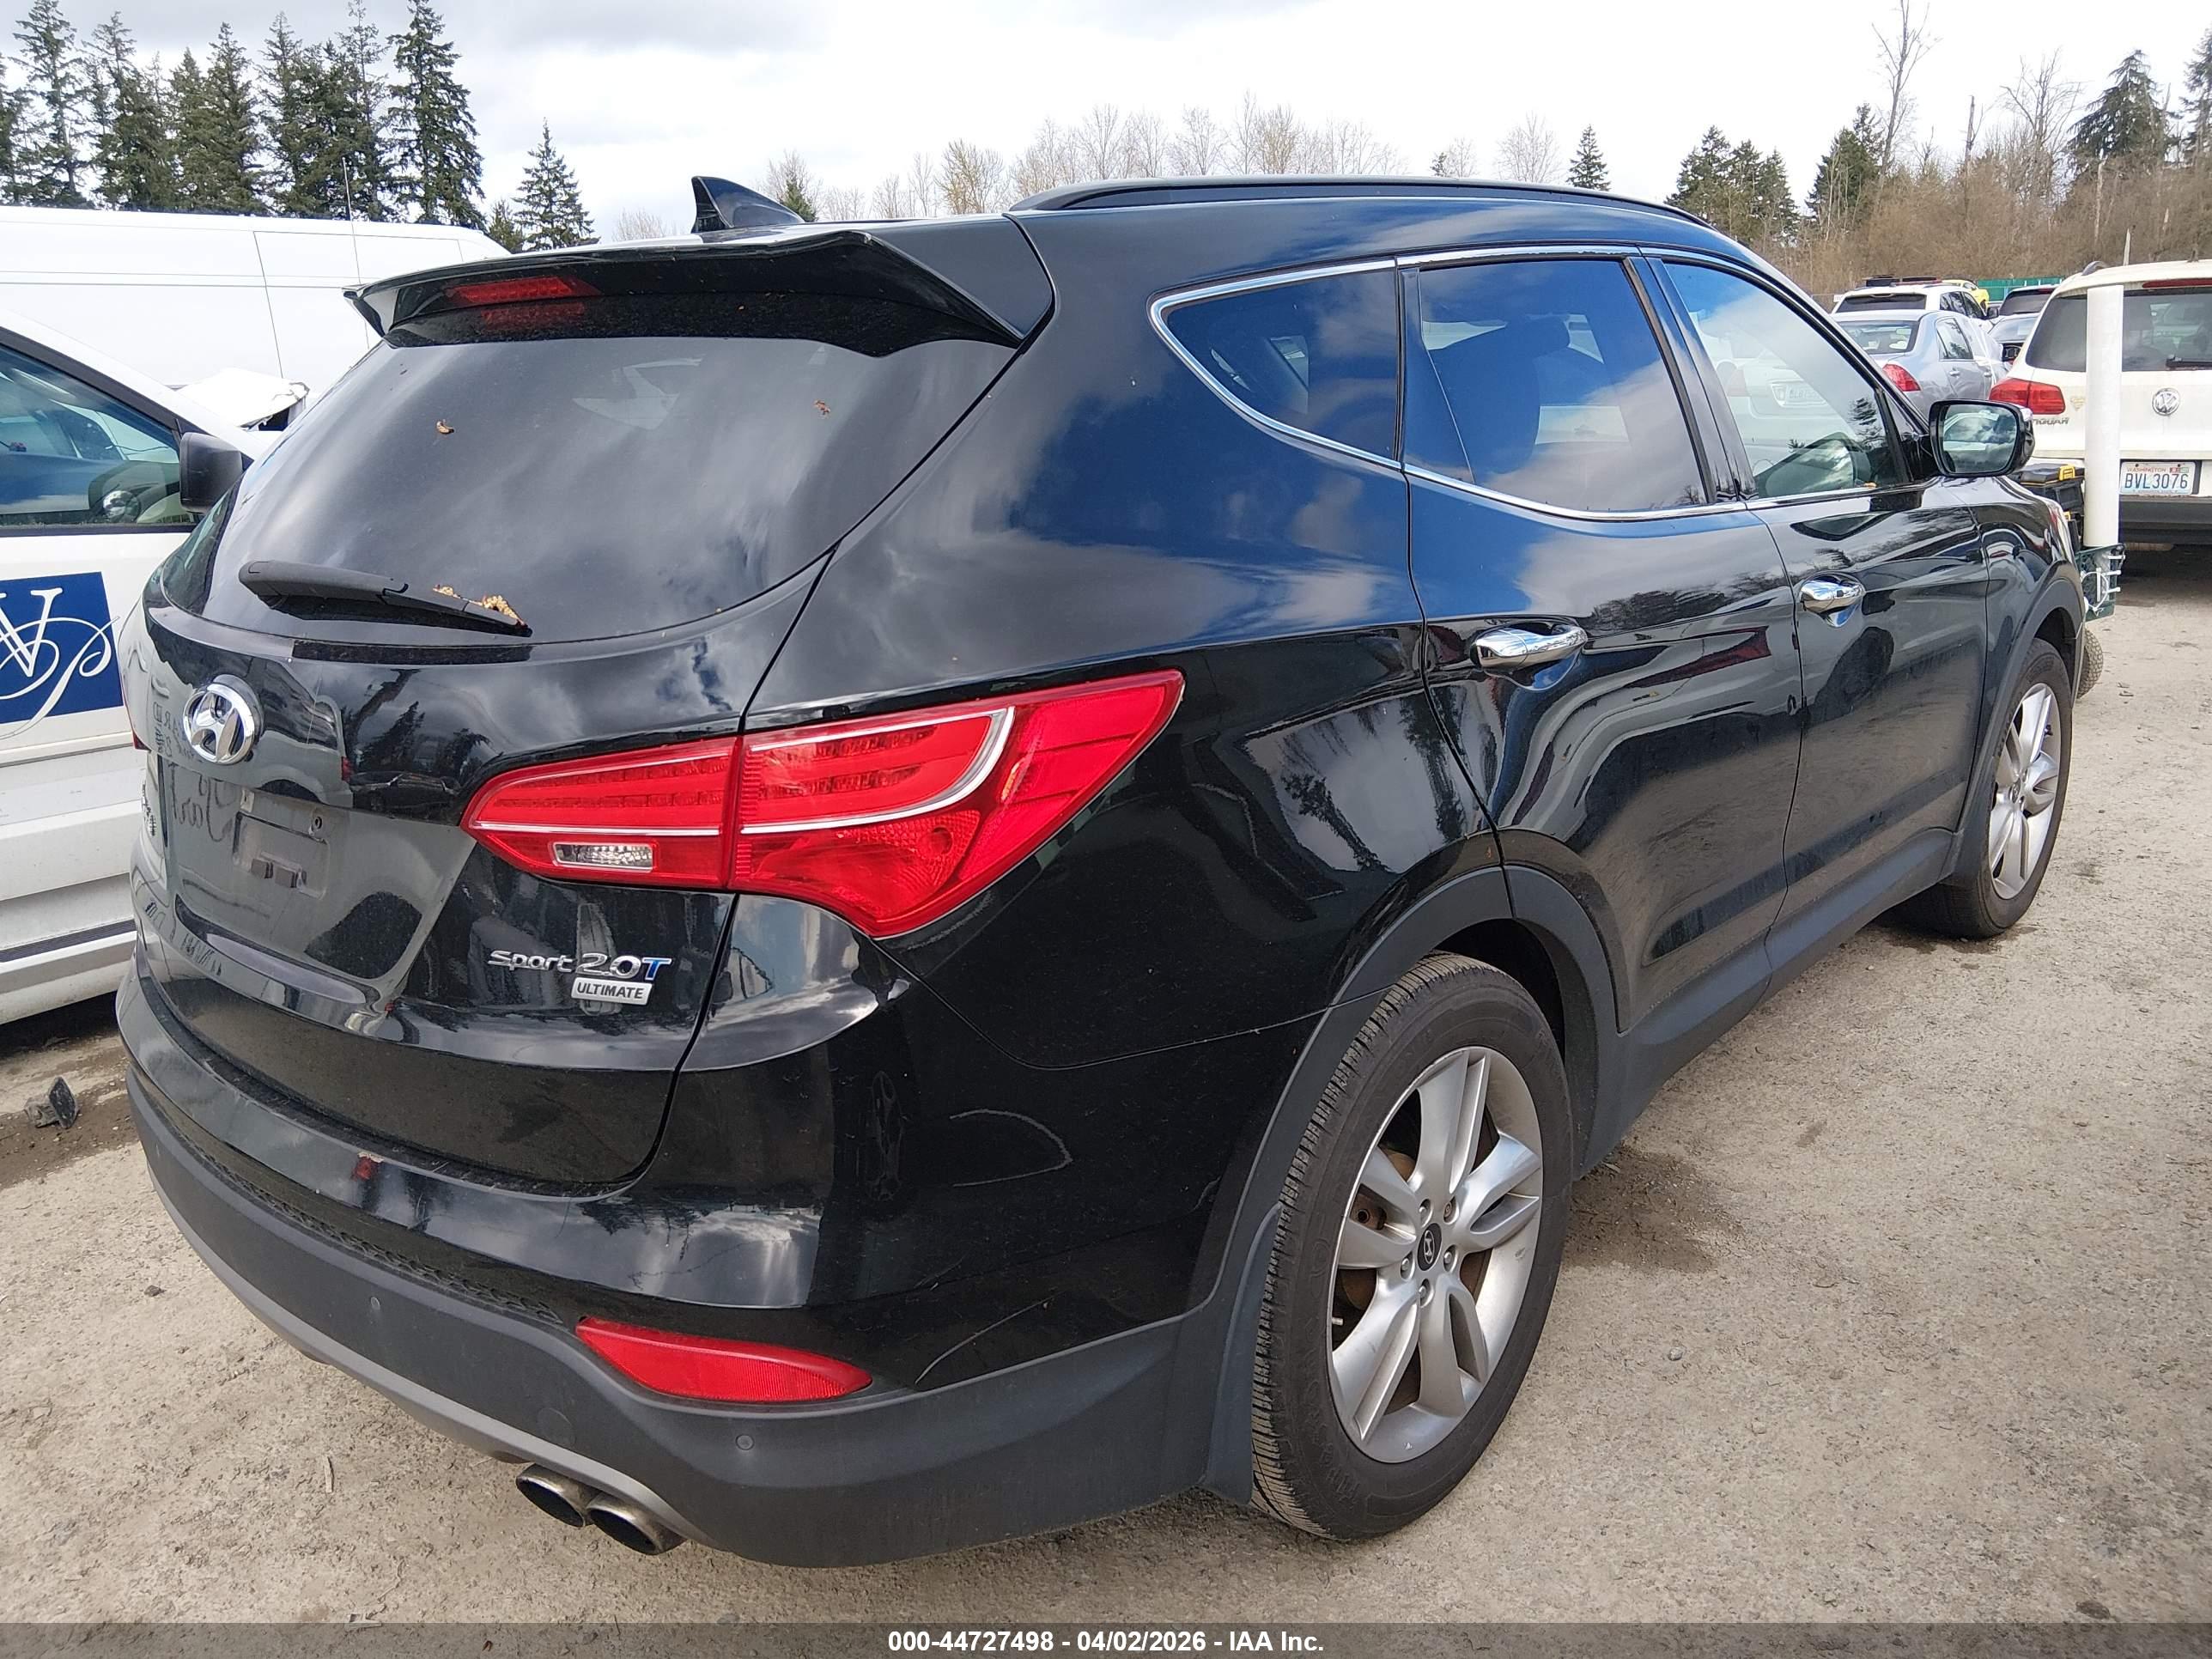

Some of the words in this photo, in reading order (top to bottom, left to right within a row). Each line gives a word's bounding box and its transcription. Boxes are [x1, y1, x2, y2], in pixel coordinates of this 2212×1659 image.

[2124, 473, 2189, 489] BVL3076
[488, 951, 573, 972] Sport
[574, 952, 672, 981] 2.0T
[577, 981, 645, 999] ULTIMATE
